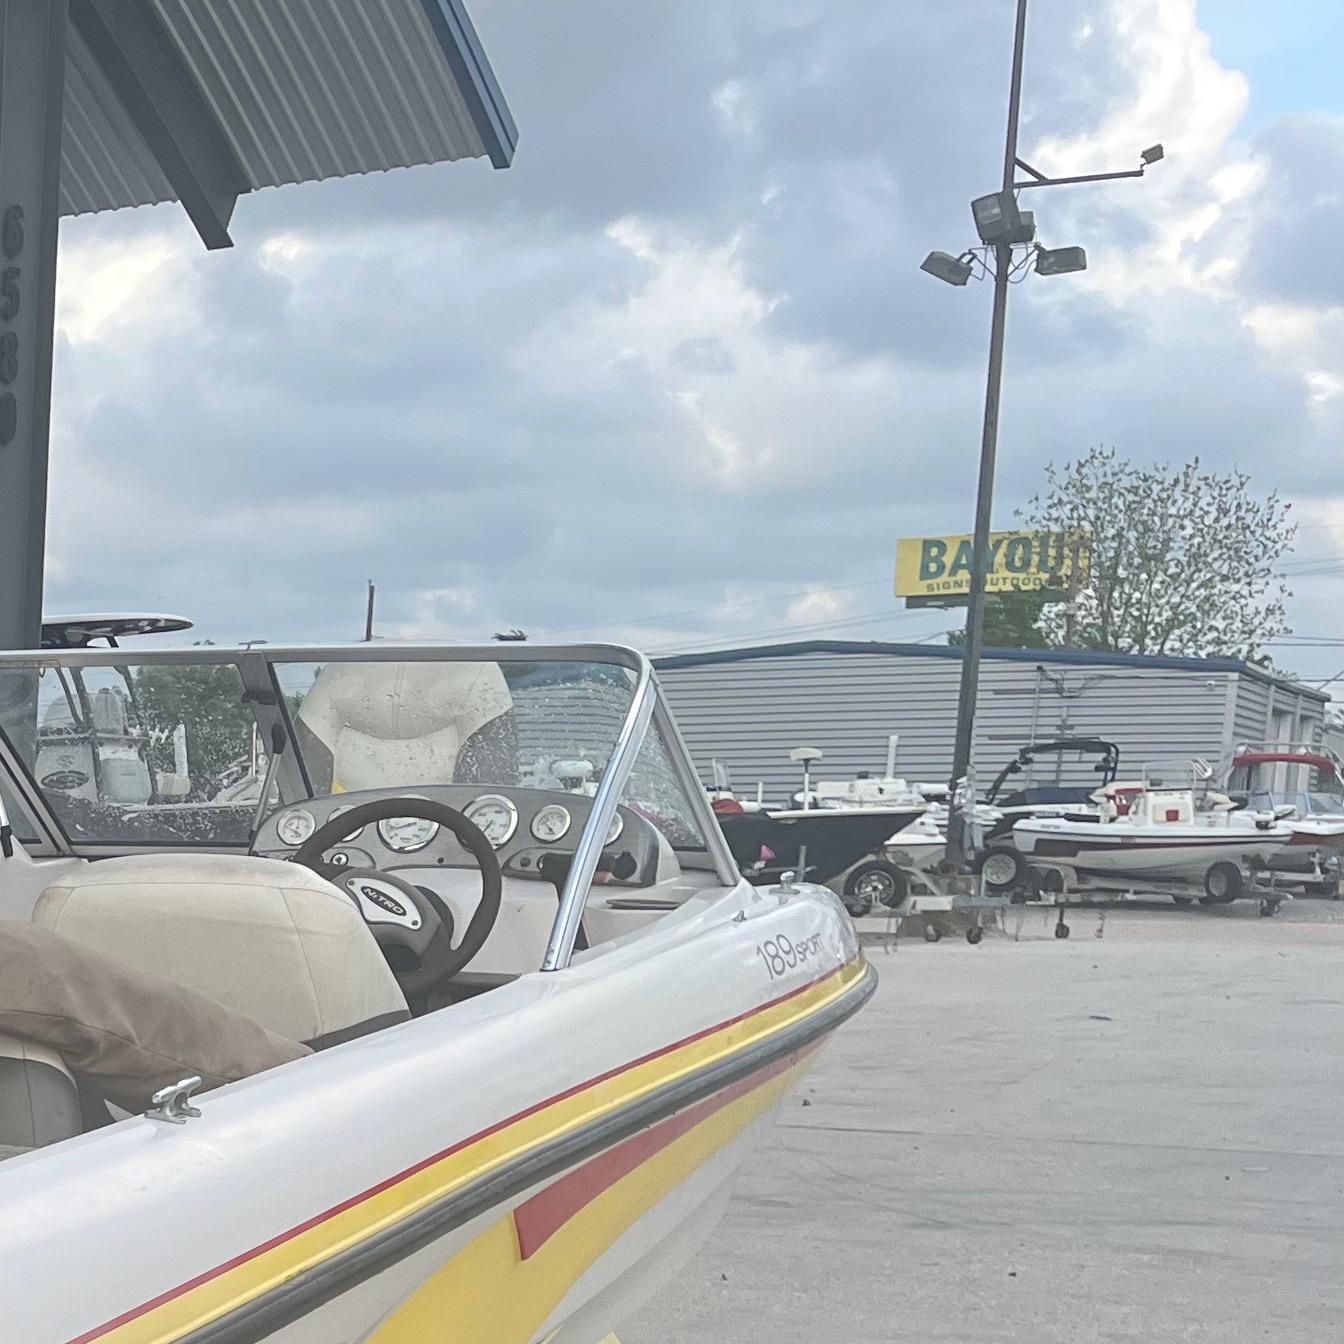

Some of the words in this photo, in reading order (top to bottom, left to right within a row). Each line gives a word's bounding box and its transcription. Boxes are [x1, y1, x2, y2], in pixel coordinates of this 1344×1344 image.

[918, 535, 1065, 582] BAYOU
[756, 933, 798, 981] 189
[794, 932, 825, 963] SPORT
